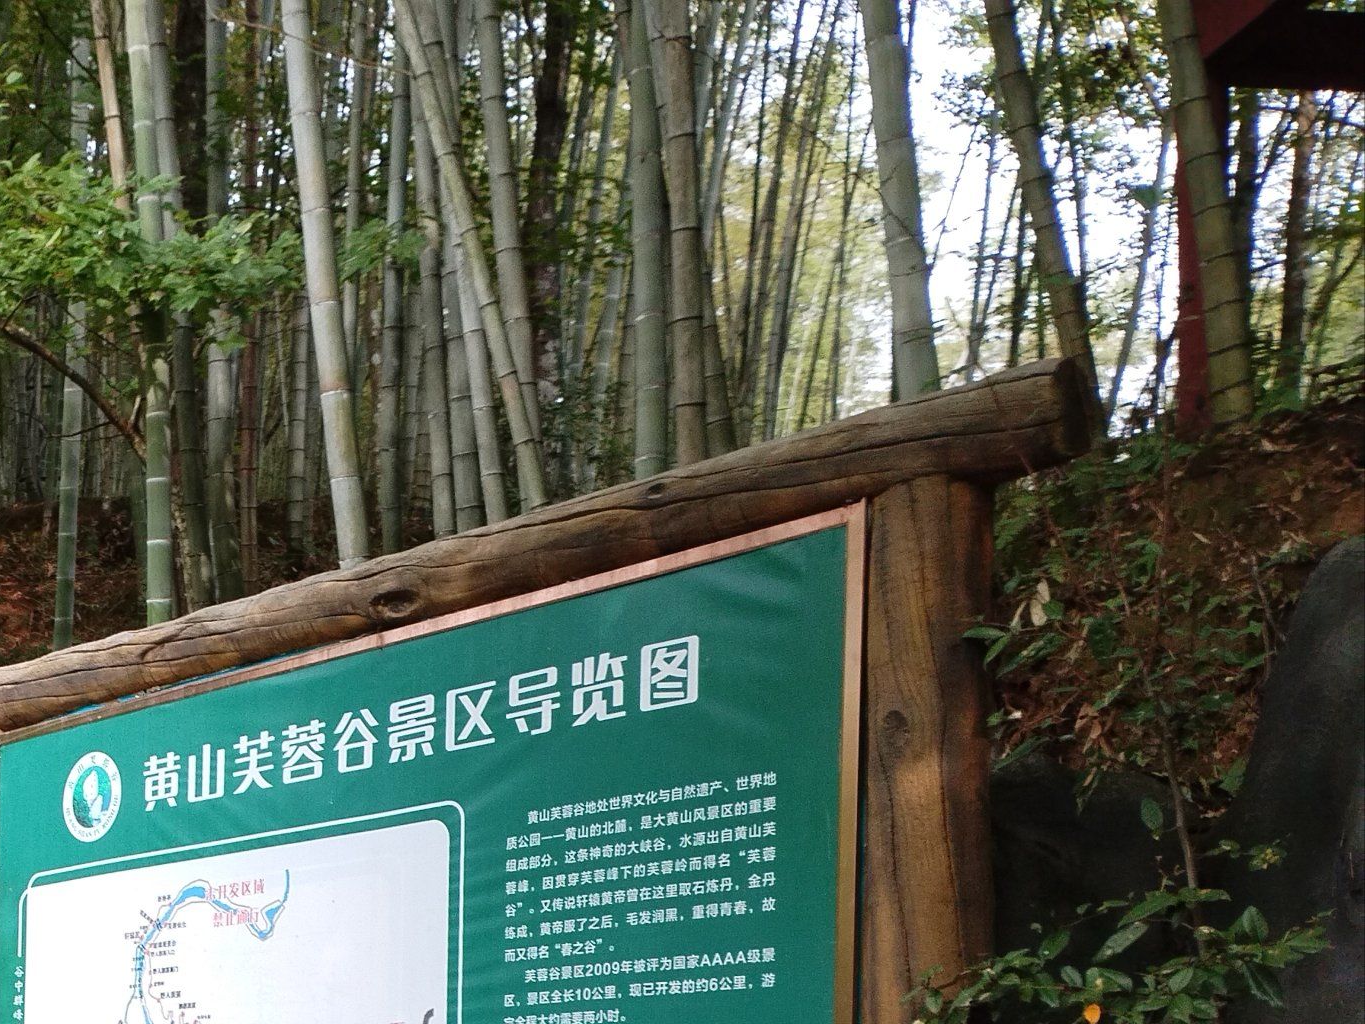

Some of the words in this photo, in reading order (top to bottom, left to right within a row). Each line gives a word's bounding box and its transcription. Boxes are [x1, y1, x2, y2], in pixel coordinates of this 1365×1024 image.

[142, 635, 700, 812] 黄山芙蓉谷景区导览图
[527, 771, 777, 825] 黄山芙蓉谷地处世界文化与自然遗产、世界地
[523, 947, 776, 983] 芙蓉谷景区2009年被评为国家AAAA级景
